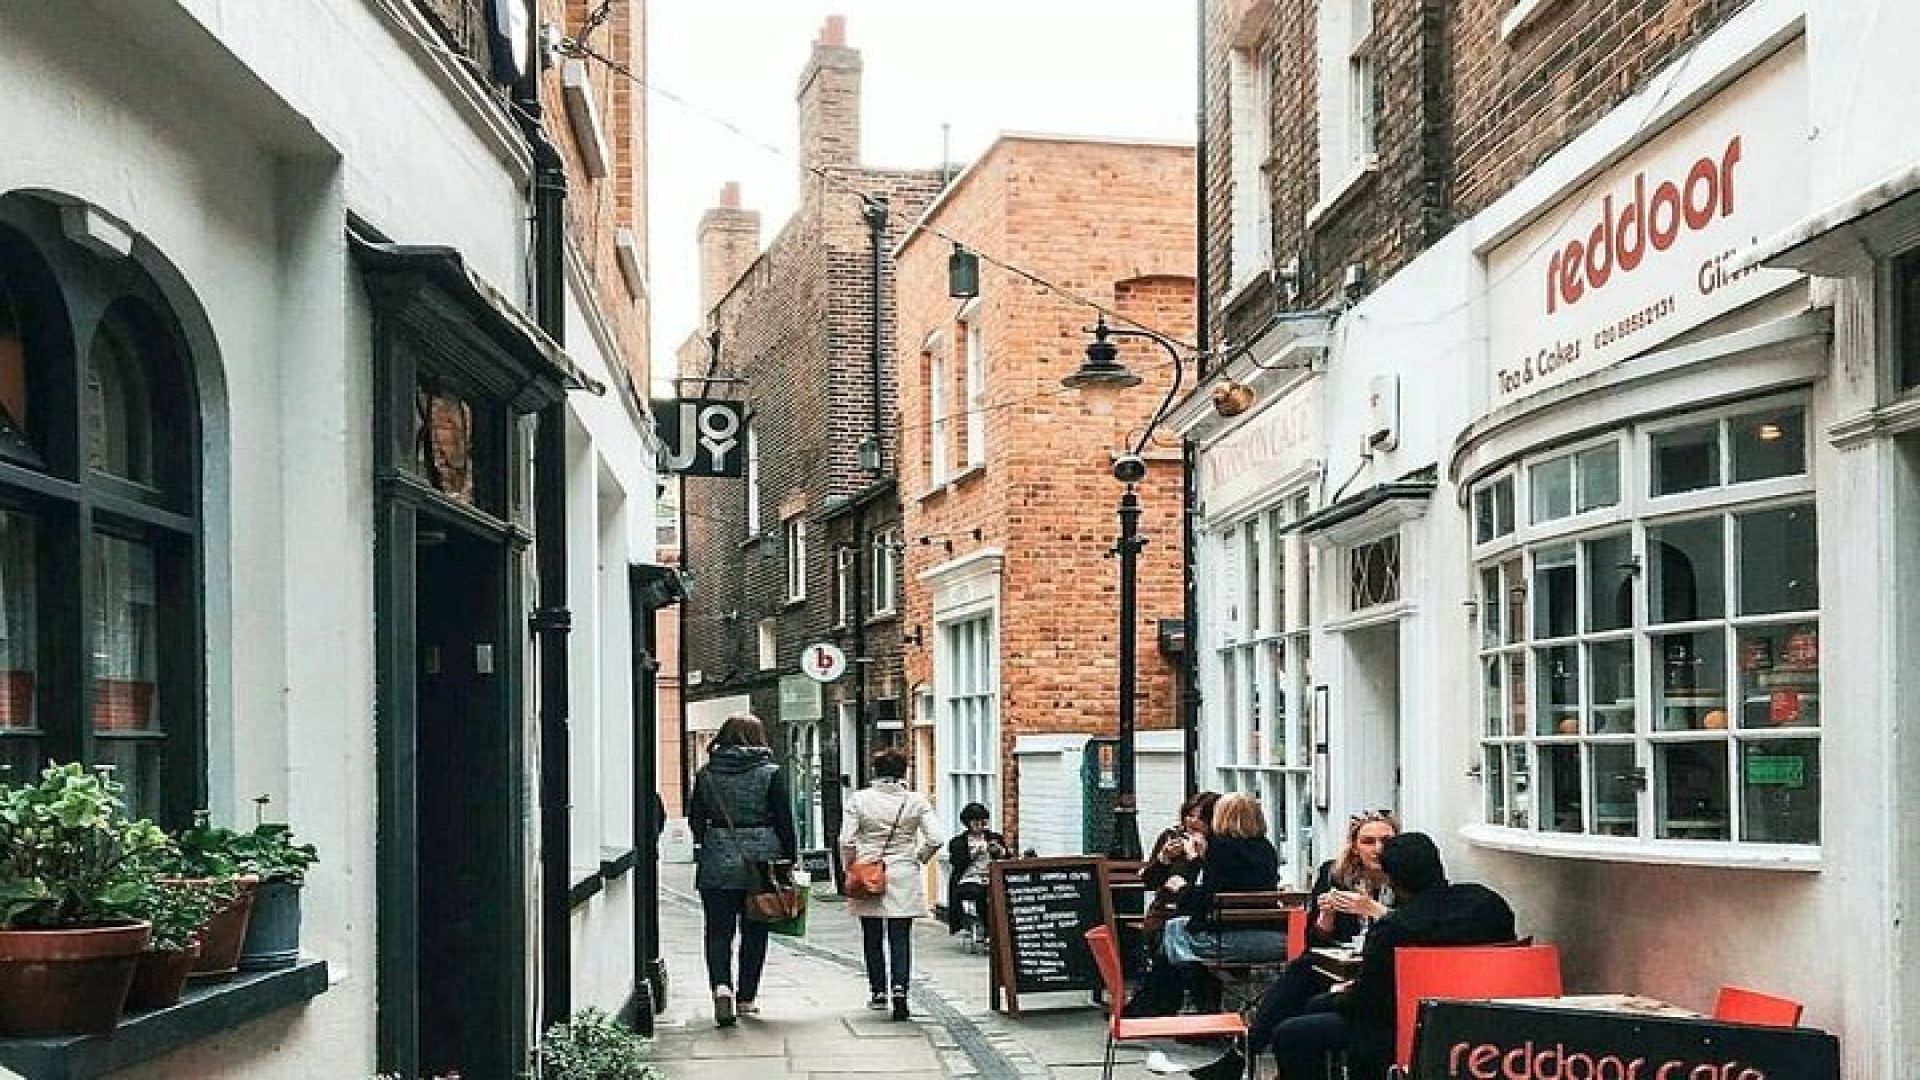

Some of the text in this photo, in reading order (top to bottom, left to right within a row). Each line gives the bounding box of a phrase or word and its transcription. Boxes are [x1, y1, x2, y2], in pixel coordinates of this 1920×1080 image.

[1546, 135, 1742, 315] reddoor
[1498, 368, 1520, 394] Tea
[1523, 357, 1533, 383] &
[1538, 339, 1580, 377] Cakes
[663, 403, 739, 471] JOY
[816, 647, 833, 669] b
[1449, 1040, 1645, 1080] reddoor
